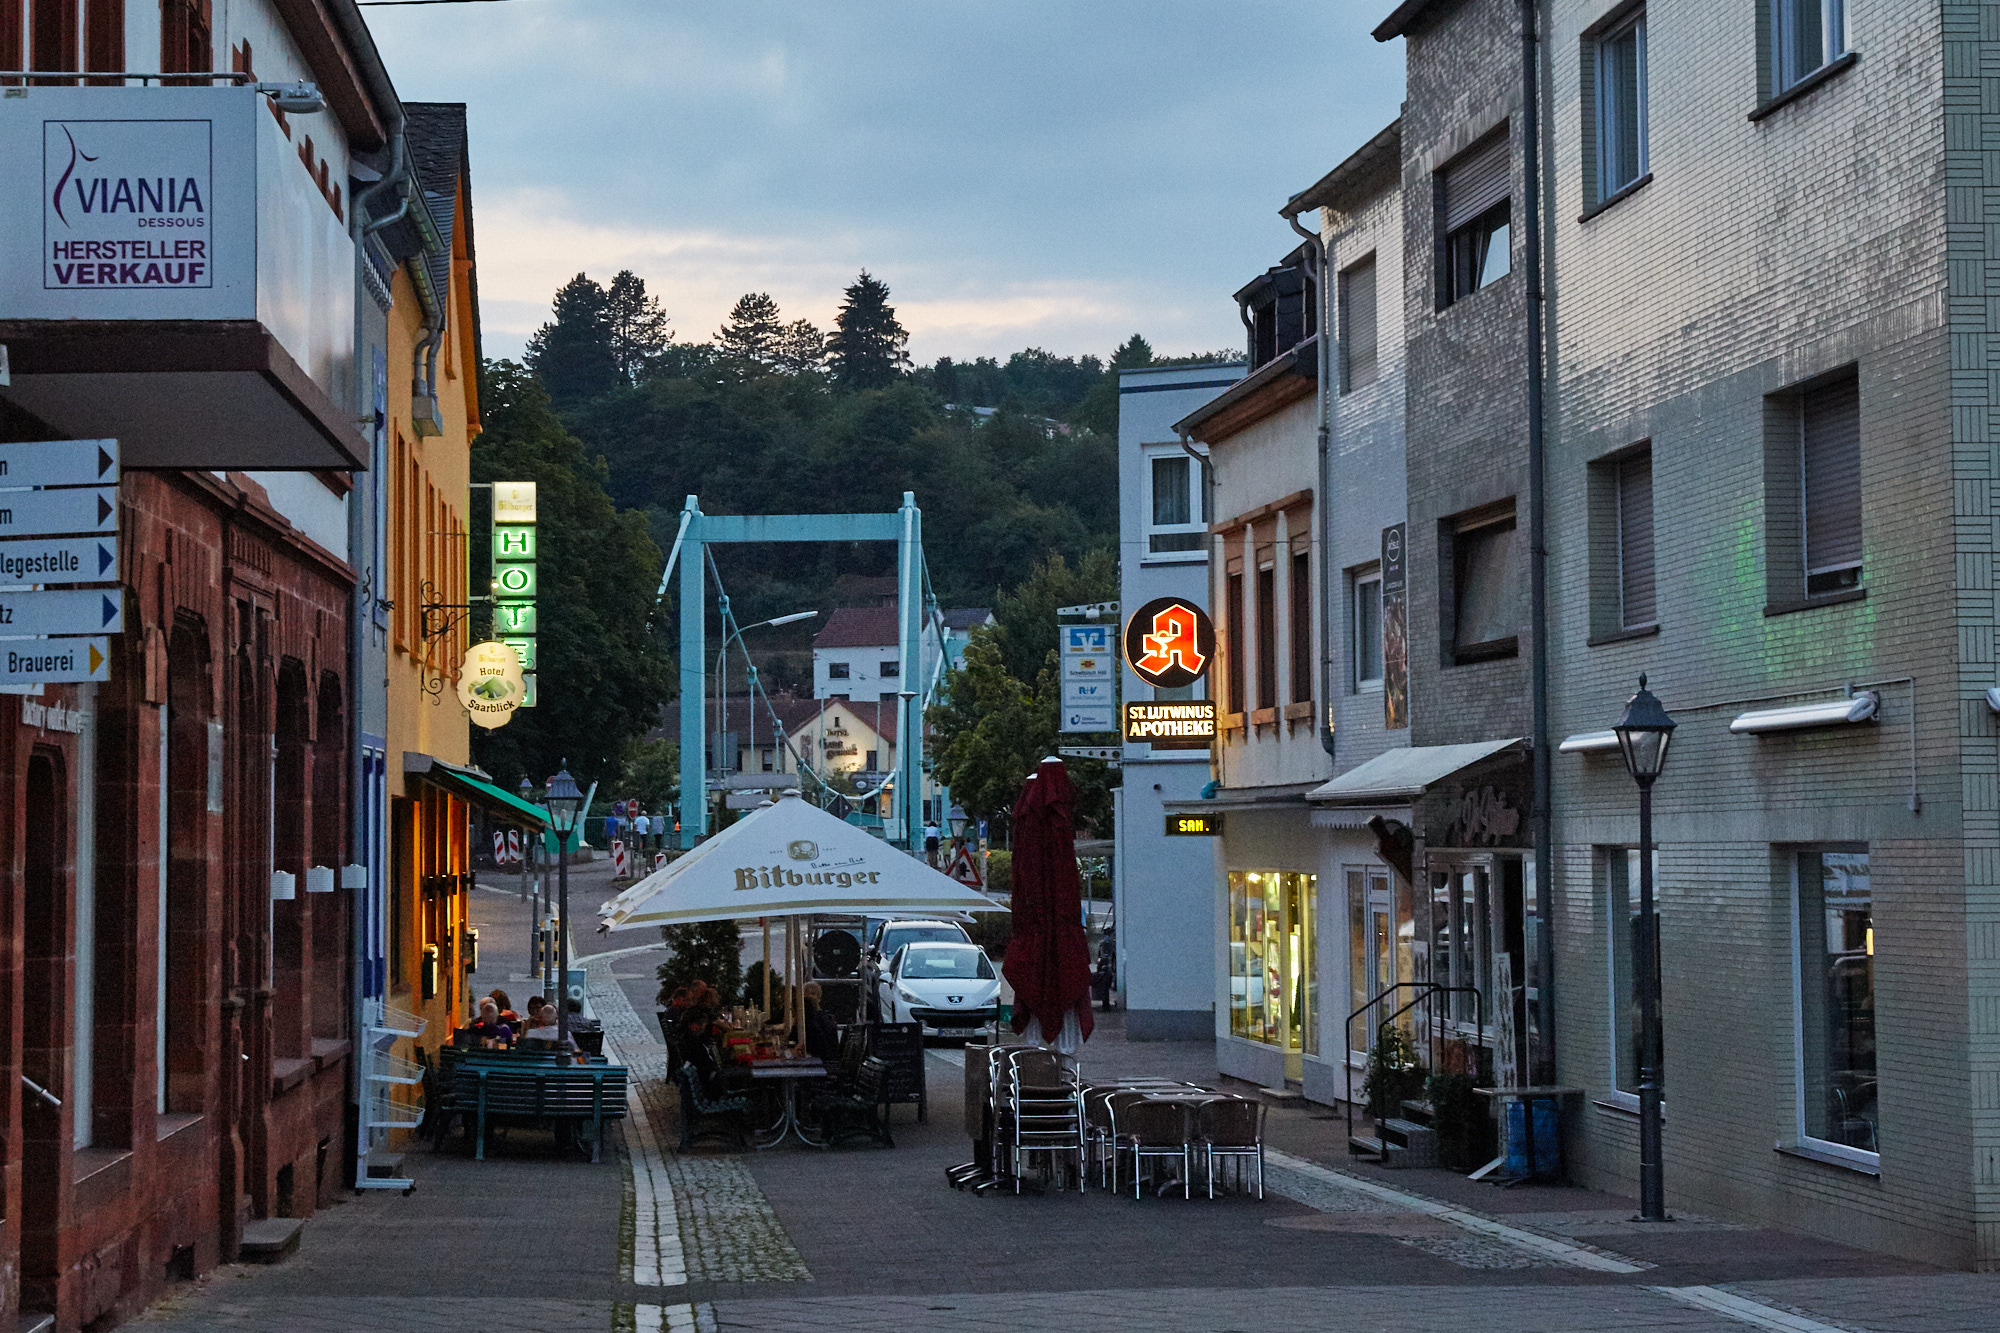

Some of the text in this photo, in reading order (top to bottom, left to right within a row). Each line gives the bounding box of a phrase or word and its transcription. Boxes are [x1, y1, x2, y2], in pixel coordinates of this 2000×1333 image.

[75, 177, 204, 213] VIANIA
[138, 217, 205, 228] DESSOUS
[53, 240, 206, 260] HERSTELLER
[53, 262, 205, 285] VERKAUF
[8, 649, 74, 673] Brauerei
[479, 667, 505, 677] Hotel
[468, 699, 516, 713] Saarblick
[1128, 720, 1214, 737] APOTHEKE
[733, 864, 881, 892] Bitburger
